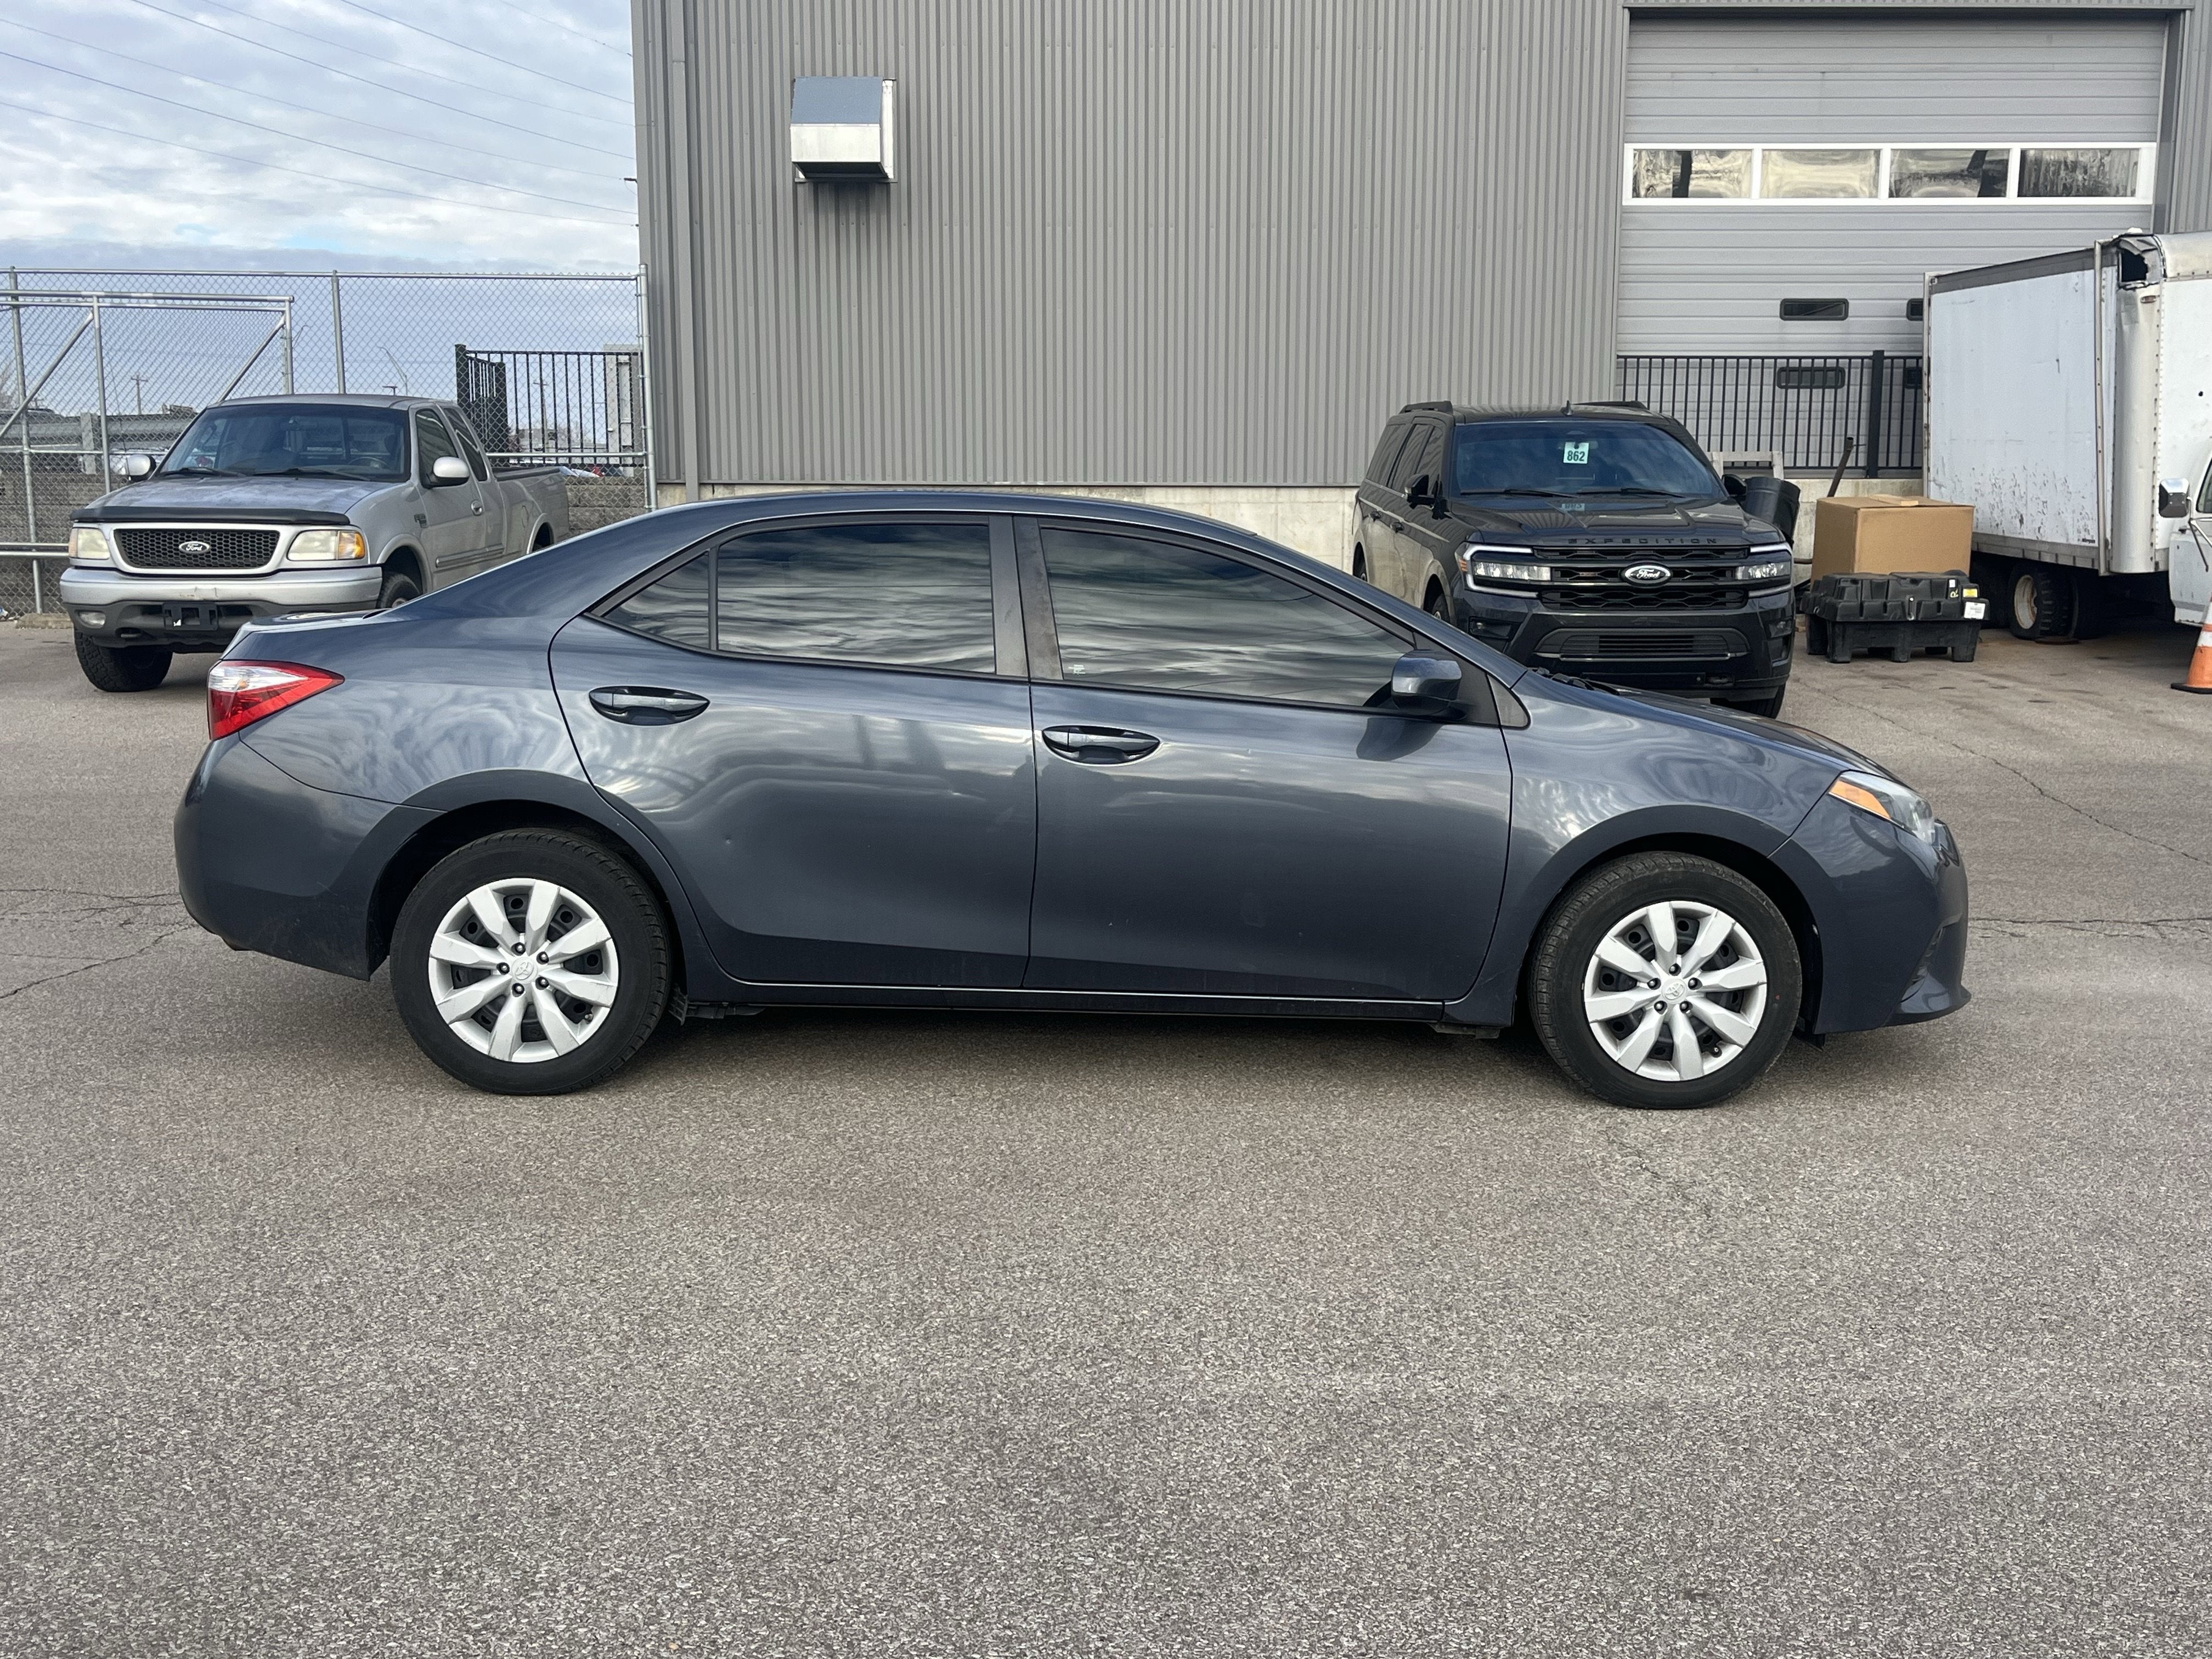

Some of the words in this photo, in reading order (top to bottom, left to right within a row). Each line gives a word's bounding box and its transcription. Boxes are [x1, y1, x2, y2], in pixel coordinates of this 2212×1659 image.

[1567, 450, 1585, 461] 862
[186, 543, 203, 551] Ford
[1636, 568, 1661, 579] Ford
